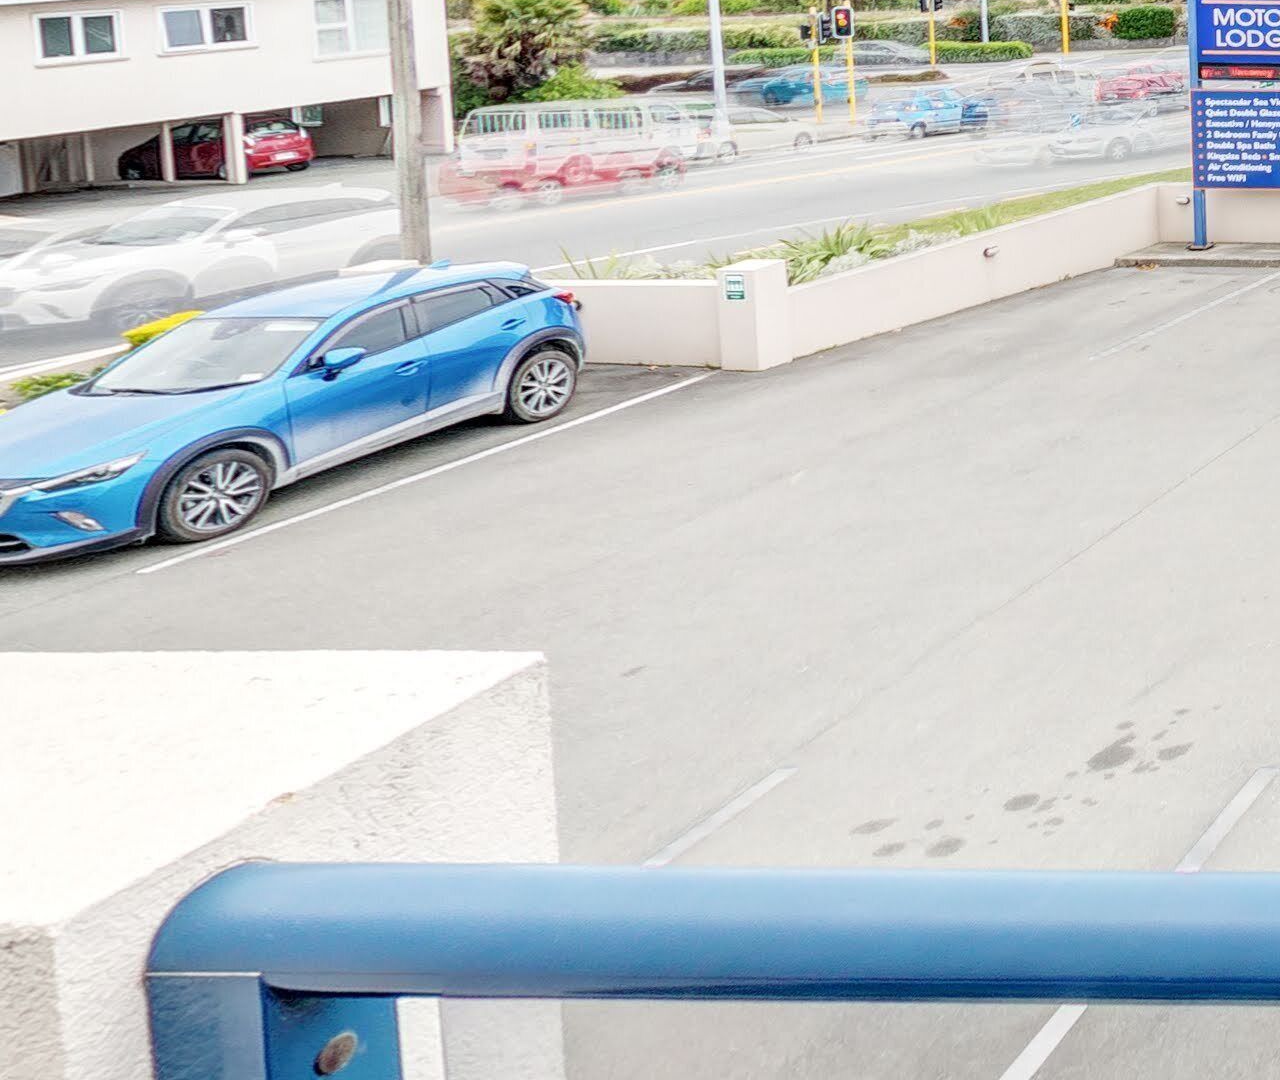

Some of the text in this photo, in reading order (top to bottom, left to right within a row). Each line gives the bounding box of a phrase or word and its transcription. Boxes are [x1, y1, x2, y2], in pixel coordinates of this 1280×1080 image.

[1205, 98, 1251, 107] Spectacular
[1253, 98, 1268, 106] Sea
[1205, 109, 1228, 118] Quiet
[1229, 109, 1257, 117] Double
[1205, 120, 1244, 128] Executive
[1213, 131, 1251, 139] Bedroom
[1252, 131, 1277, 140] Family
[1236, 142, 1252, 151] Spa
[1241, 152, 1261, 160] Beds
[1207, 163, 1272, 173] Air Conditioning
[1207, 174, 1226, 182] Free
